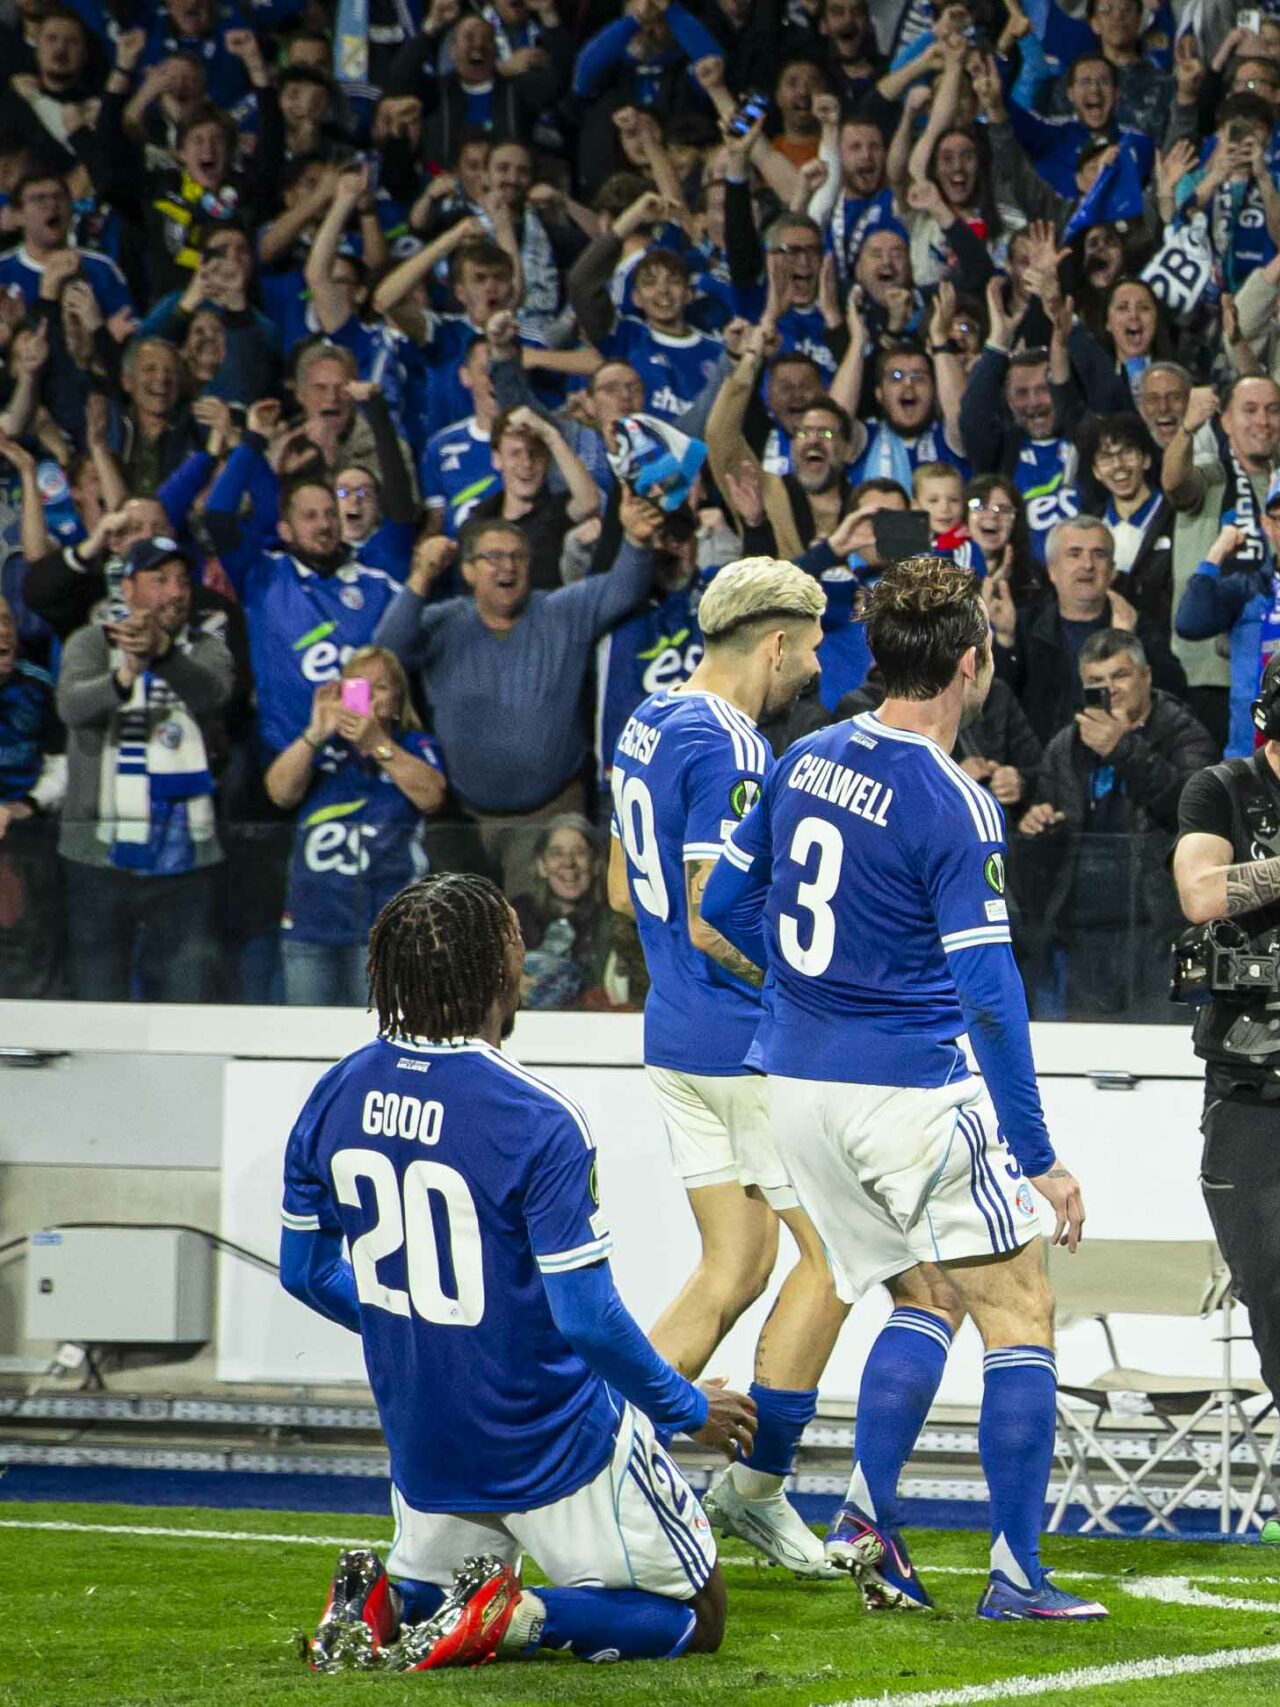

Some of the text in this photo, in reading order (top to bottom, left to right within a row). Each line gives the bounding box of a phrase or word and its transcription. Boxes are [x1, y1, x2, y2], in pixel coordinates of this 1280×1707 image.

[788, 753, 893, 827] CHILWELL
[779, 816, 844, 978] 3
[362, 1090, 445, 1146] GODO
[331, 1148, 484, 1327] 20
